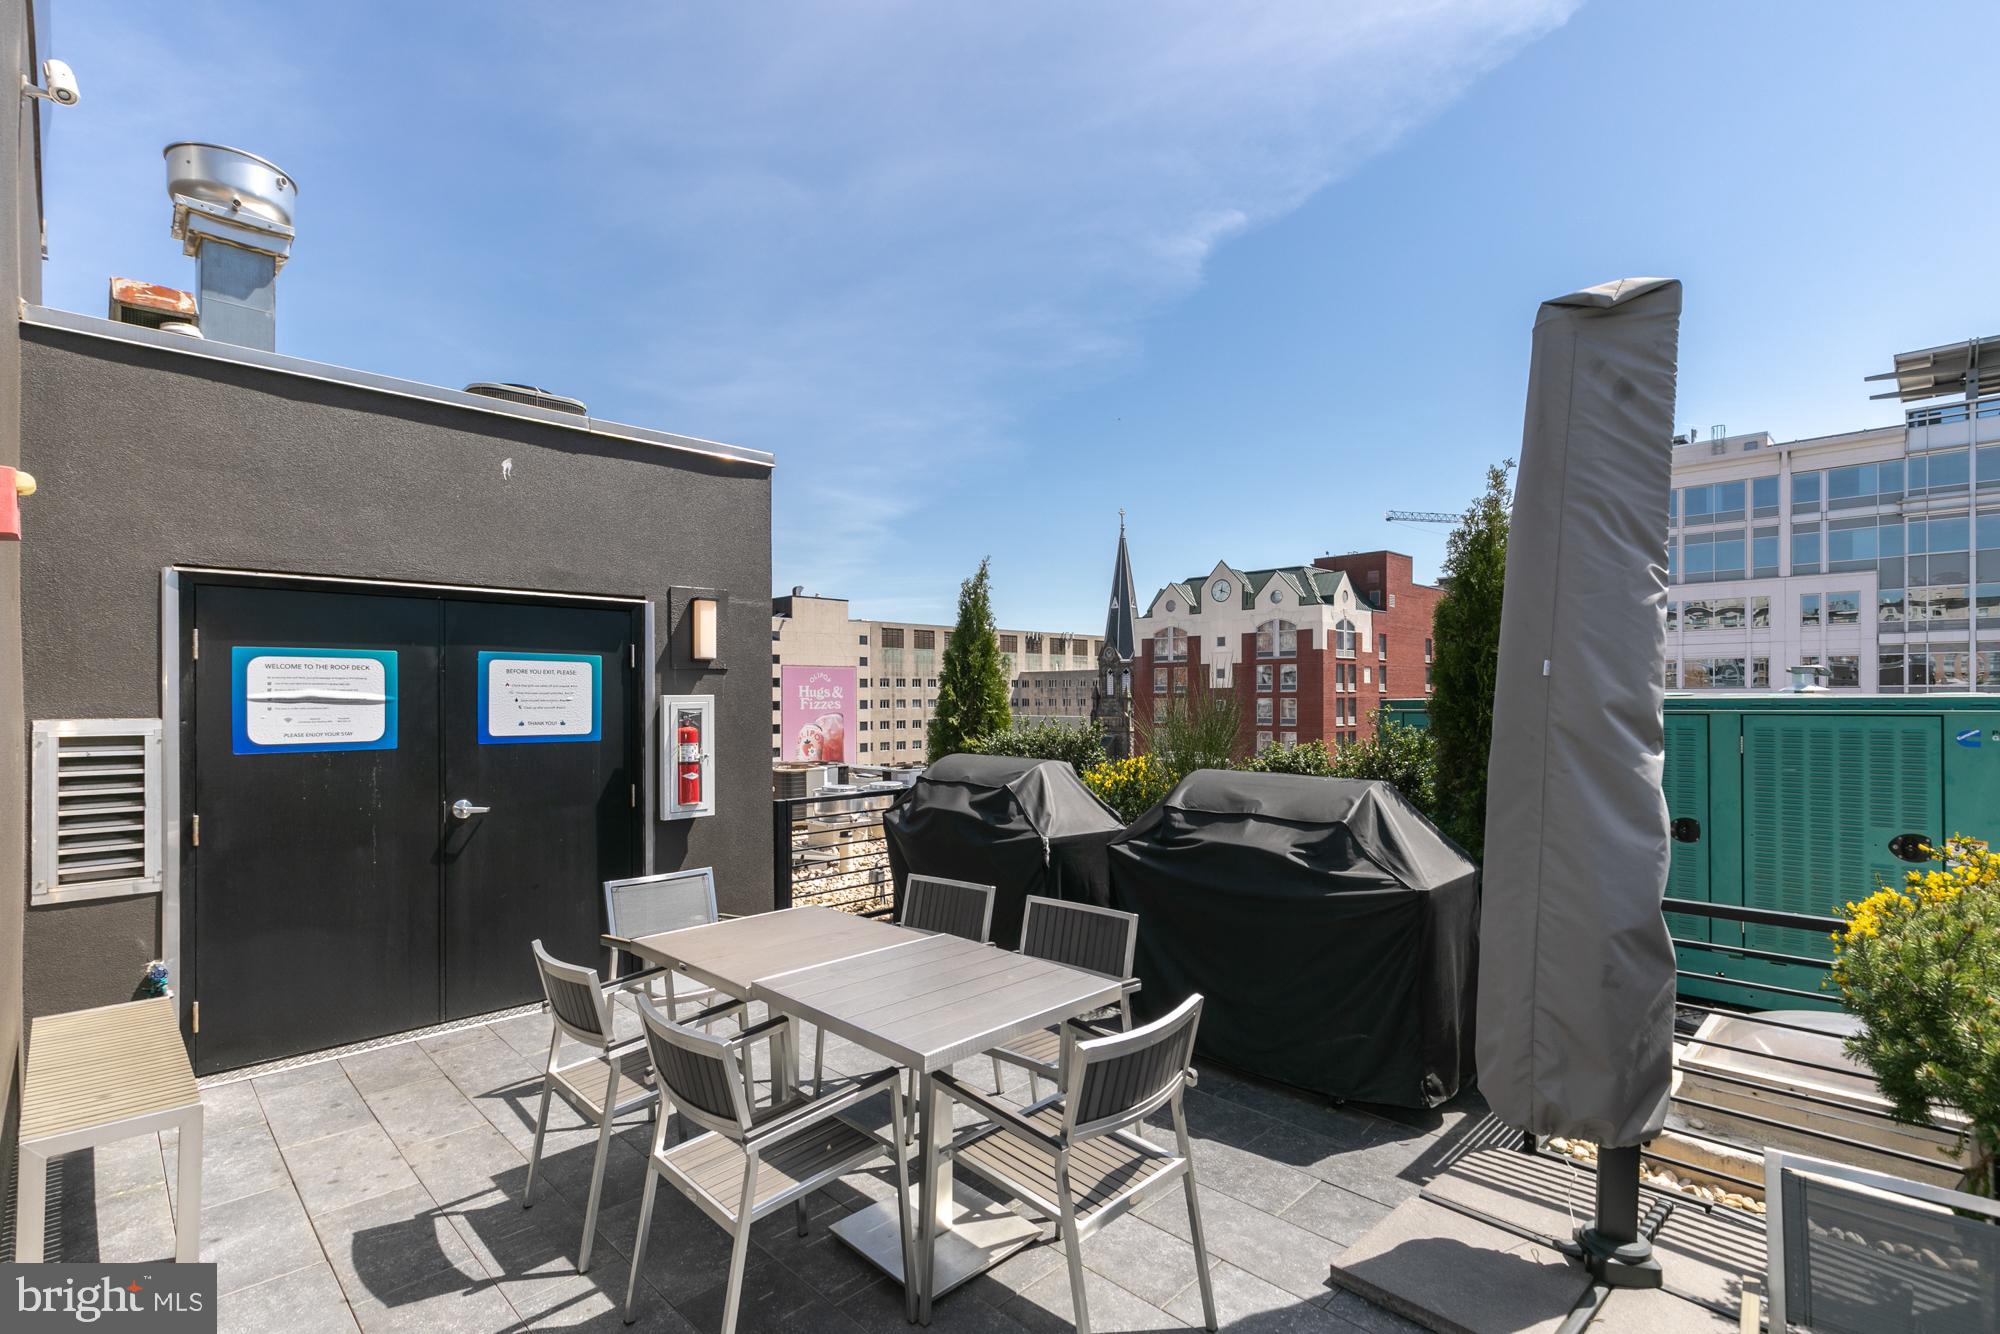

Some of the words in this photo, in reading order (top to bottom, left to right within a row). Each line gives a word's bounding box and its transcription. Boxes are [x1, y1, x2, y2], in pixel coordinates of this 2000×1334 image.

[798, 685, 831, 700] Hugs
[832, 686, 844, 698] &
[800, 698, 842, 710] Fizzes
